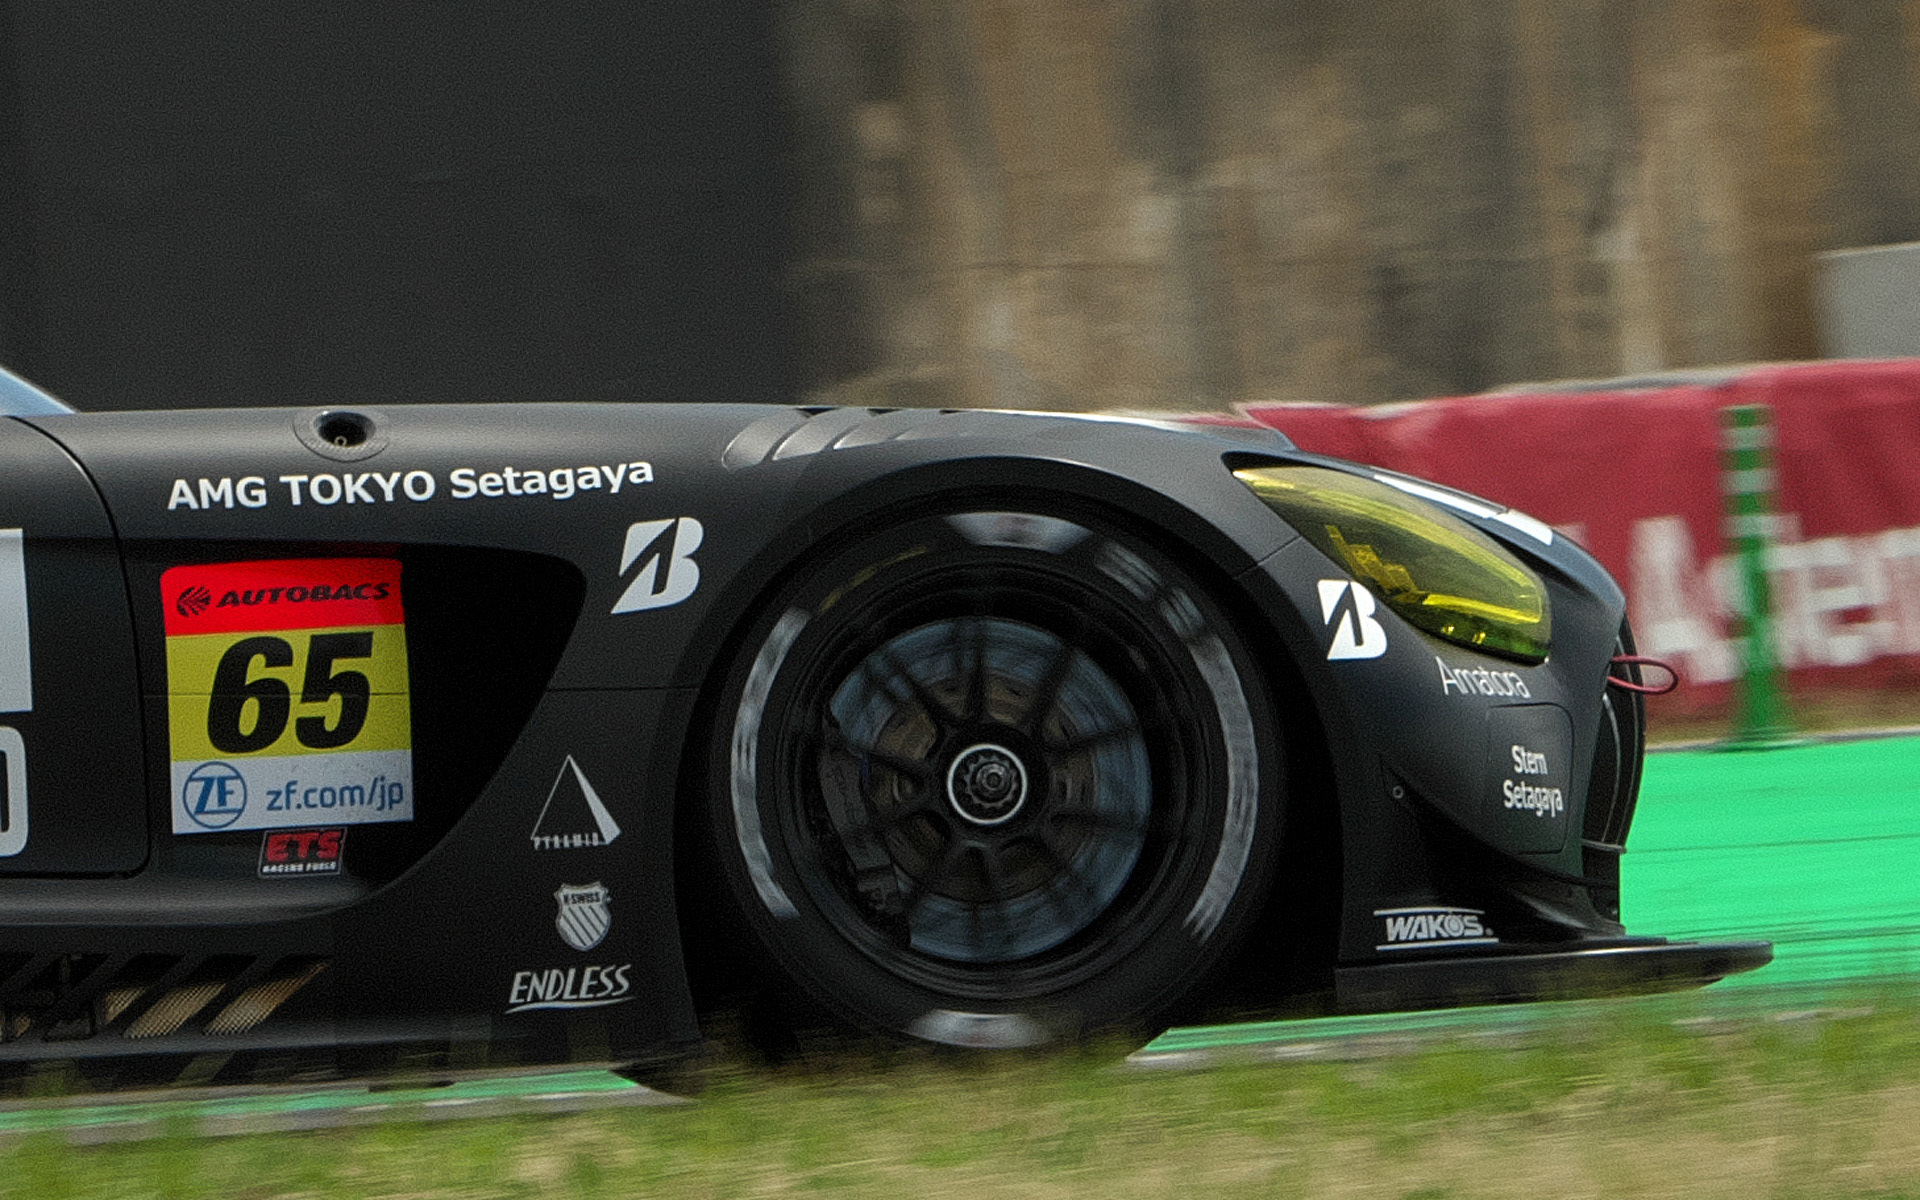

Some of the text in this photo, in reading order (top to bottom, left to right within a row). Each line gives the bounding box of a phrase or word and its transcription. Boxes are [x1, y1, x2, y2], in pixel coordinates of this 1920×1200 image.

[167, 460, 655, 510] AMG TOKYO Setagaya
[216, 582, 390, 608] AUTOBACS
[207, 631, 374, 754] 65
[1435, 655, 1531, 698] Amatora
[189, 776, 242, 815] ZF
[266, 776, 404, 811] zf.com/jp
[1503, 779, 1564, 818] Setagaya
[266, 831, 340, 862] ETS
[509, 964, 631, 1003] ENDLESS
